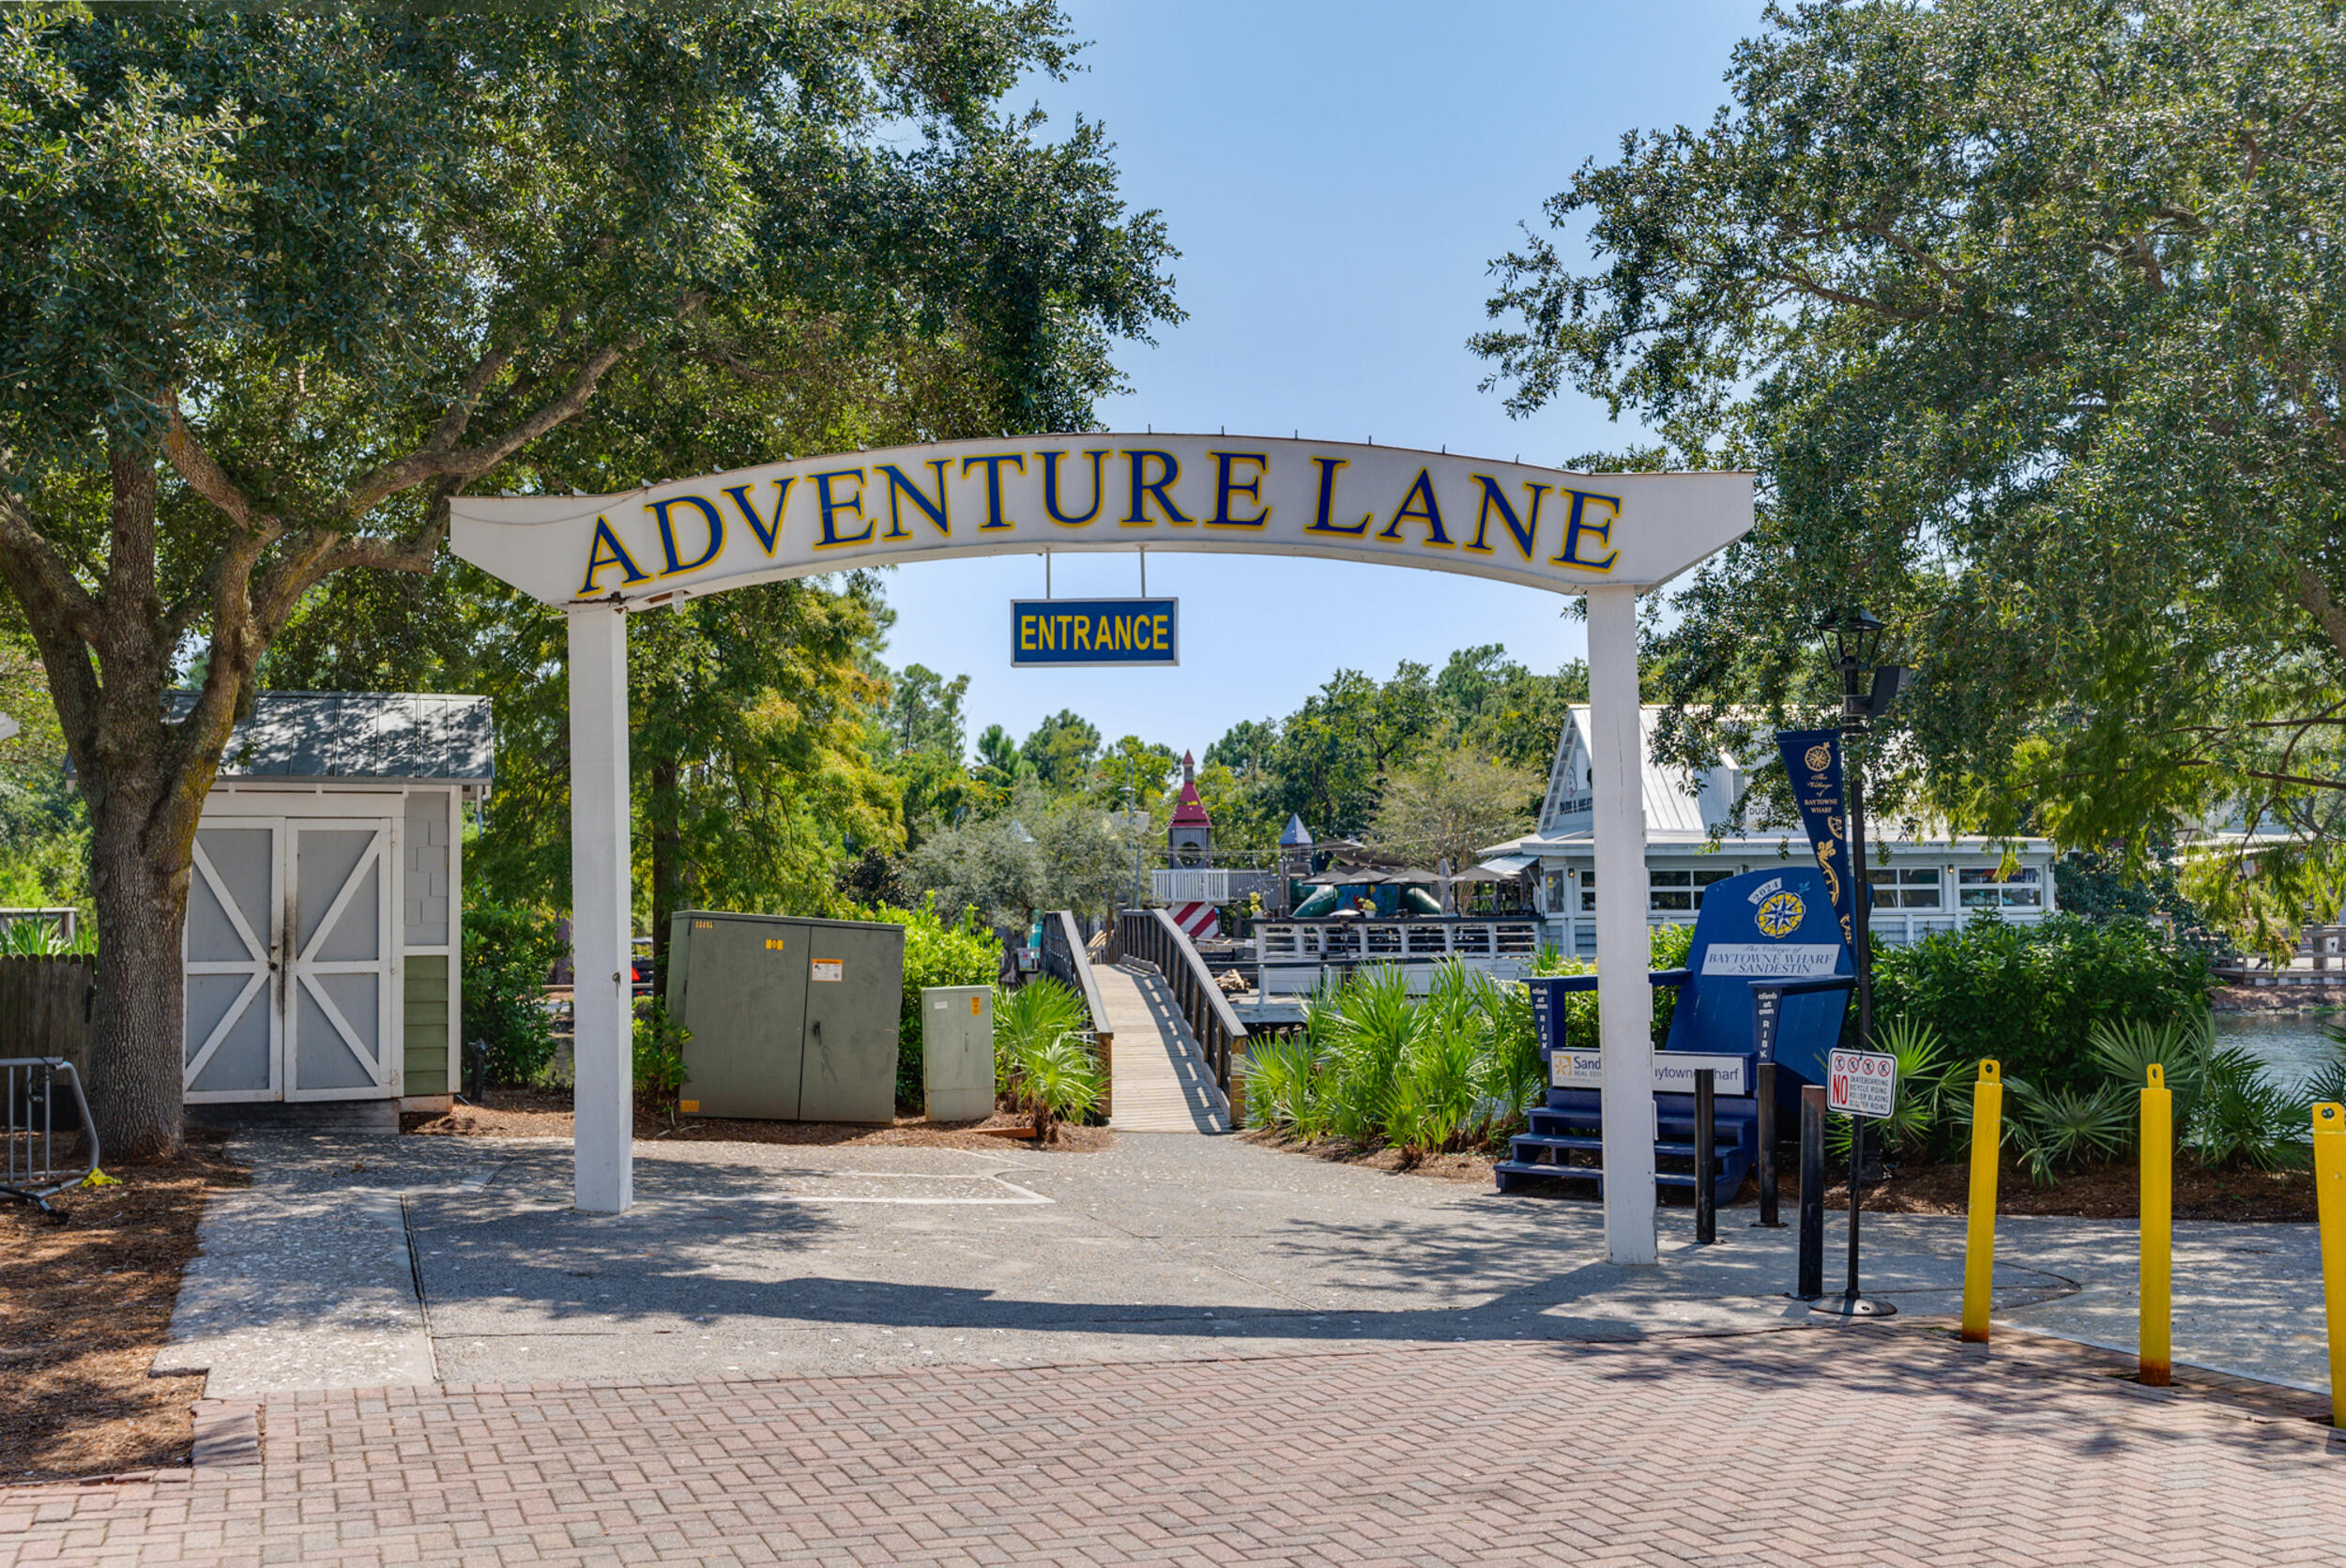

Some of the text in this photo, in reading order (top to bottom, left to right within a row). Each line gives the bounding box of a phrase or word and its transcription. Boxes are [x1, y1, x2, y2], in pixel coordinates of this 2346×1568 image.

[576, 448, 1622, 599] ADVENTURE LANE
[1021, 615, 1169, 650] ENTRANCE
[1753, 881, 1779, 902] 2024
[1709, 953, 1834, 965] BAYTOWNE WHARF
[1761, 945, 1790, 954] Village
[1791, 945, 1803, 954] of
[1738, 964, 1811, 974] SANDESTIN
[1758, 992, 1778, 1000] climb
[1760, 1019, 1770, 1058] RISK
[1574, 1056, 1601, 1070] Sand
[1714, 1068, 1739, 1080] harf
[1833, 1073, 1849, 1105] NO
